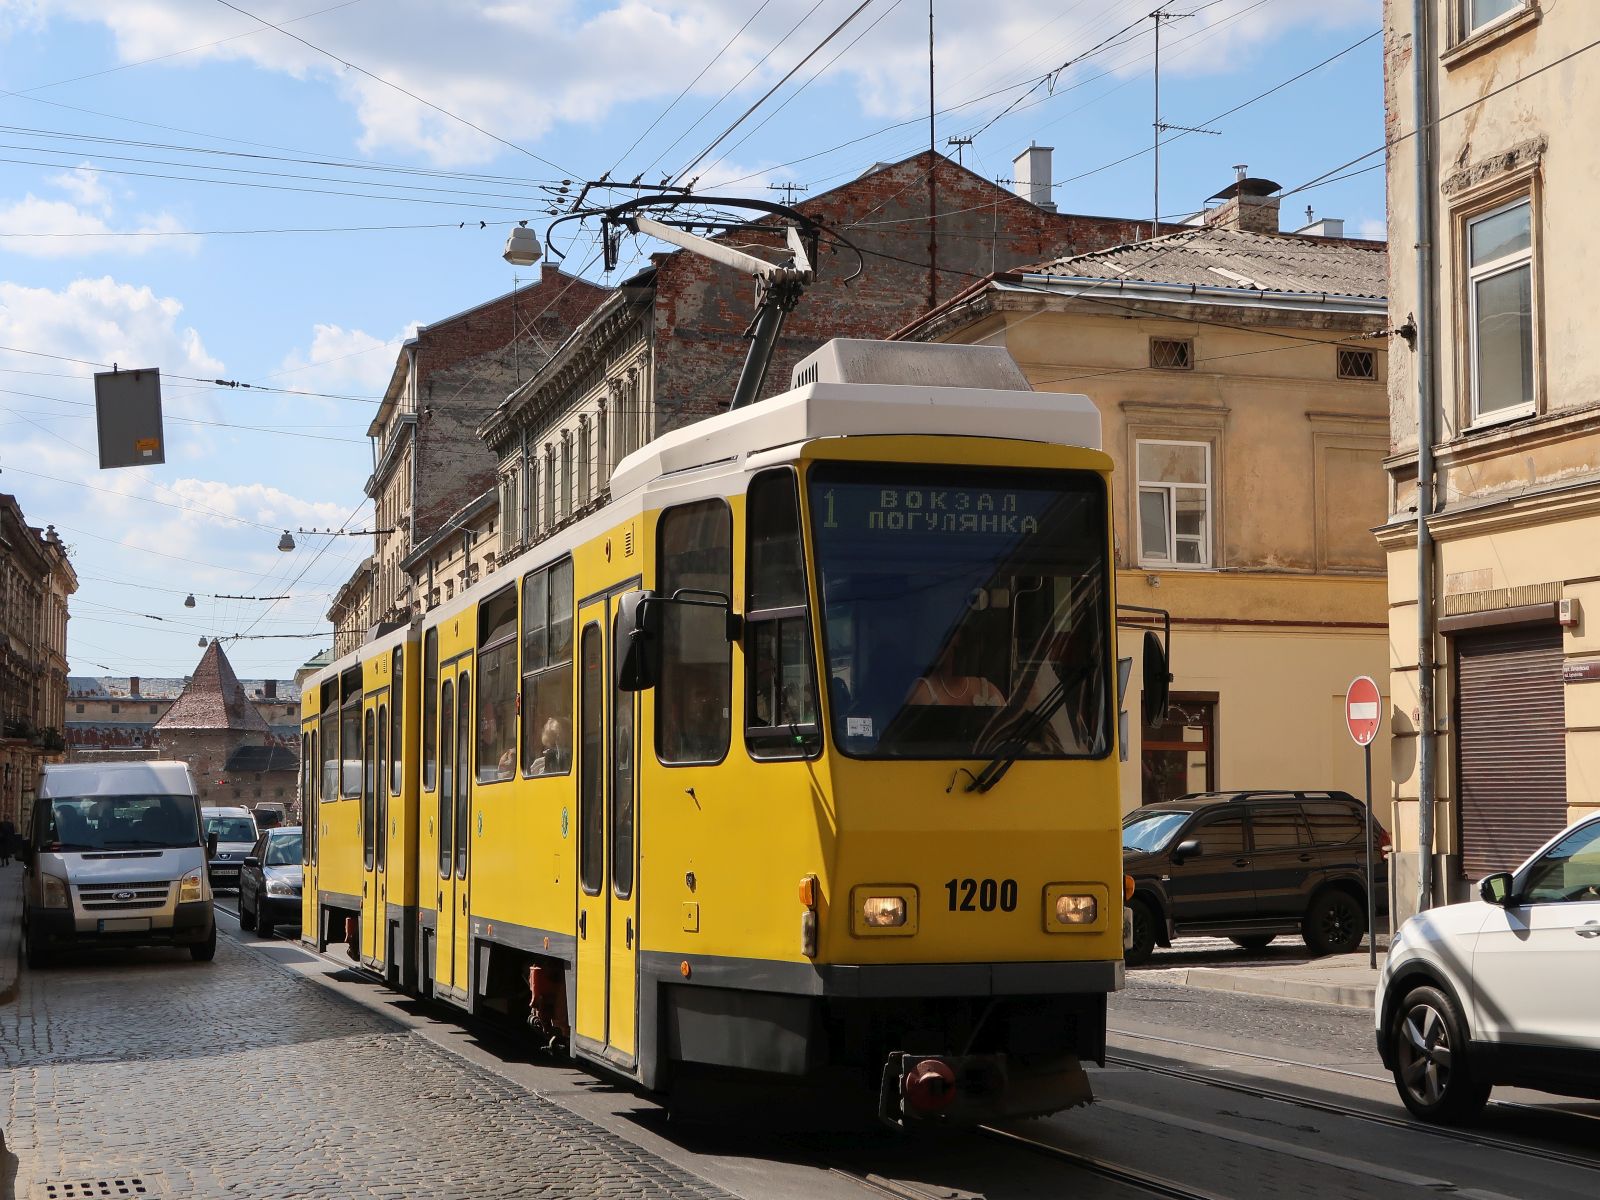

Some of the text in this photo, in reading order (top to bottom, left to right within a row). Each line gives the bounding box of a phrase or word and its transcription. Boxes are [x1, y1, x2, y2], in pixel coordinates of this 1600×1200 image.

[823, 488, 838, 528] 1
[880, 489, 1016, 512] ВОКЗАЛ
[869, 511, 1038, 534] ПОГУЛЯНКА
[944, 878, 1018, 912] 1200
